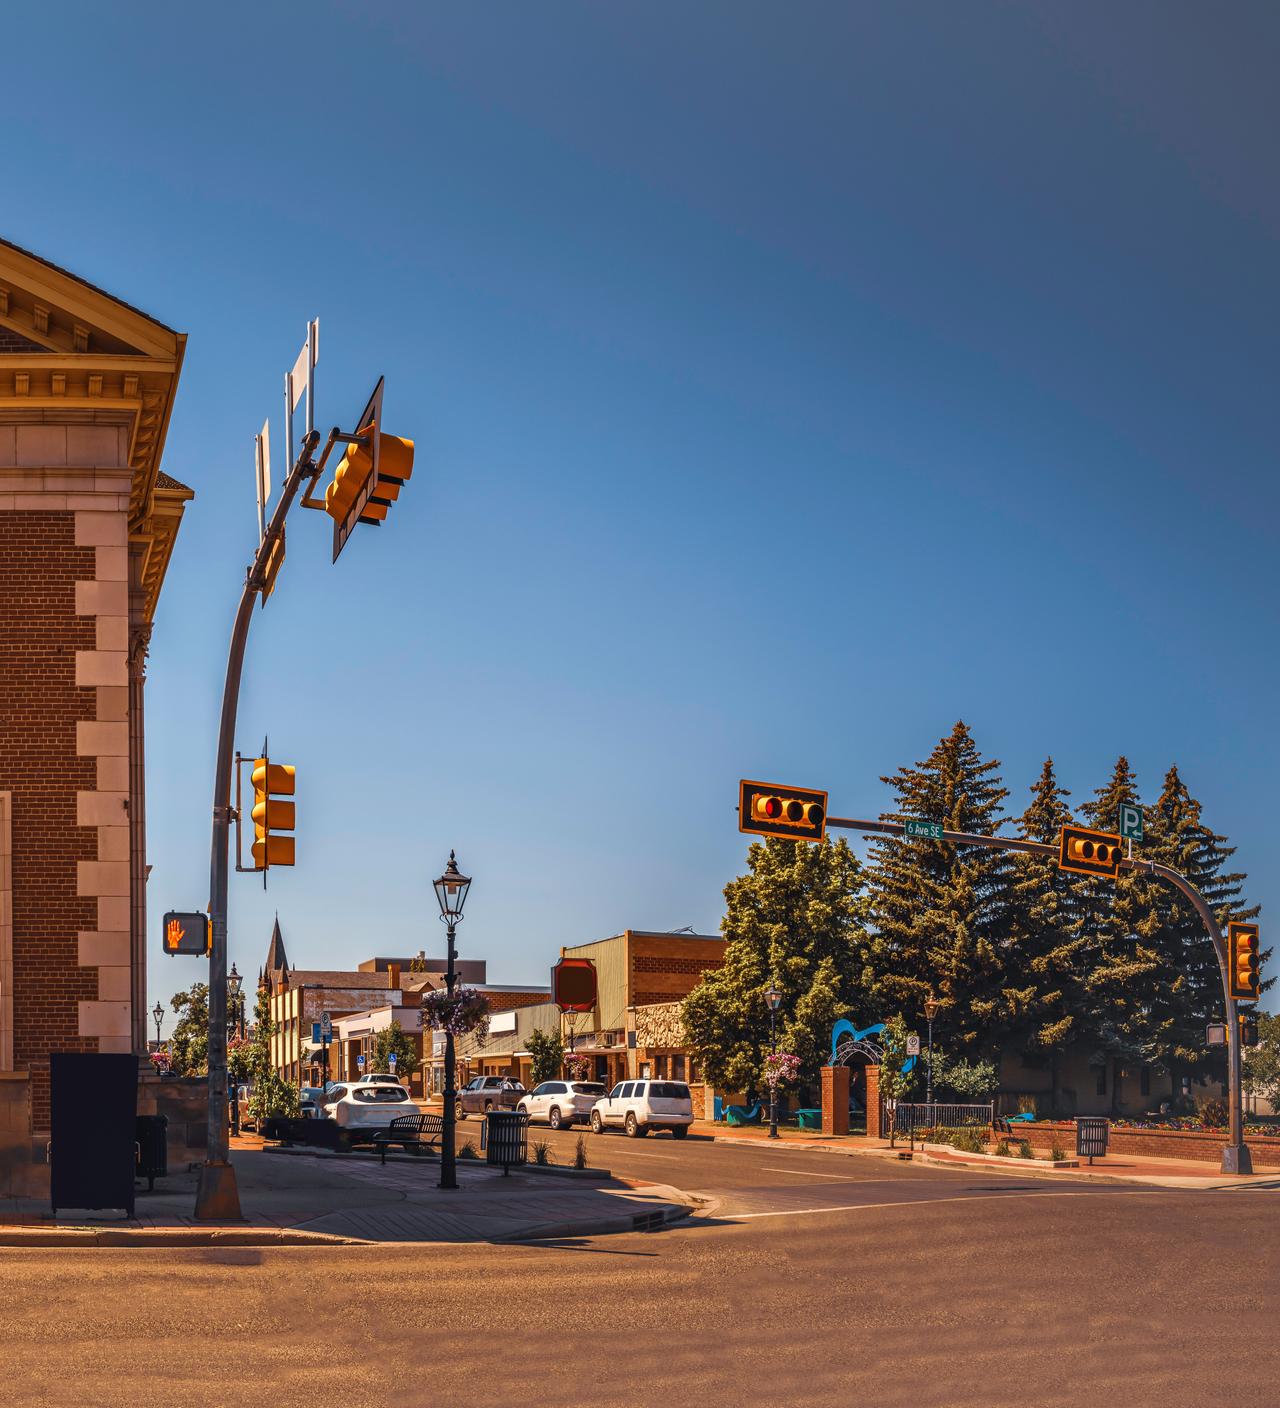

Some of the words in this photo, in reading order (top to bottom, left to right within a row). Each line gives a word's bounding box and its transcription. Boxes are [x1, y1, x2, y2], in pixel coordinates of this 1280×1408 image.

[908, 823, 913, 834] 6
[915, 824, 929, 836] Ave
[930, 826, 940, 837] SE
[1124, 807, 1139, 834] P
